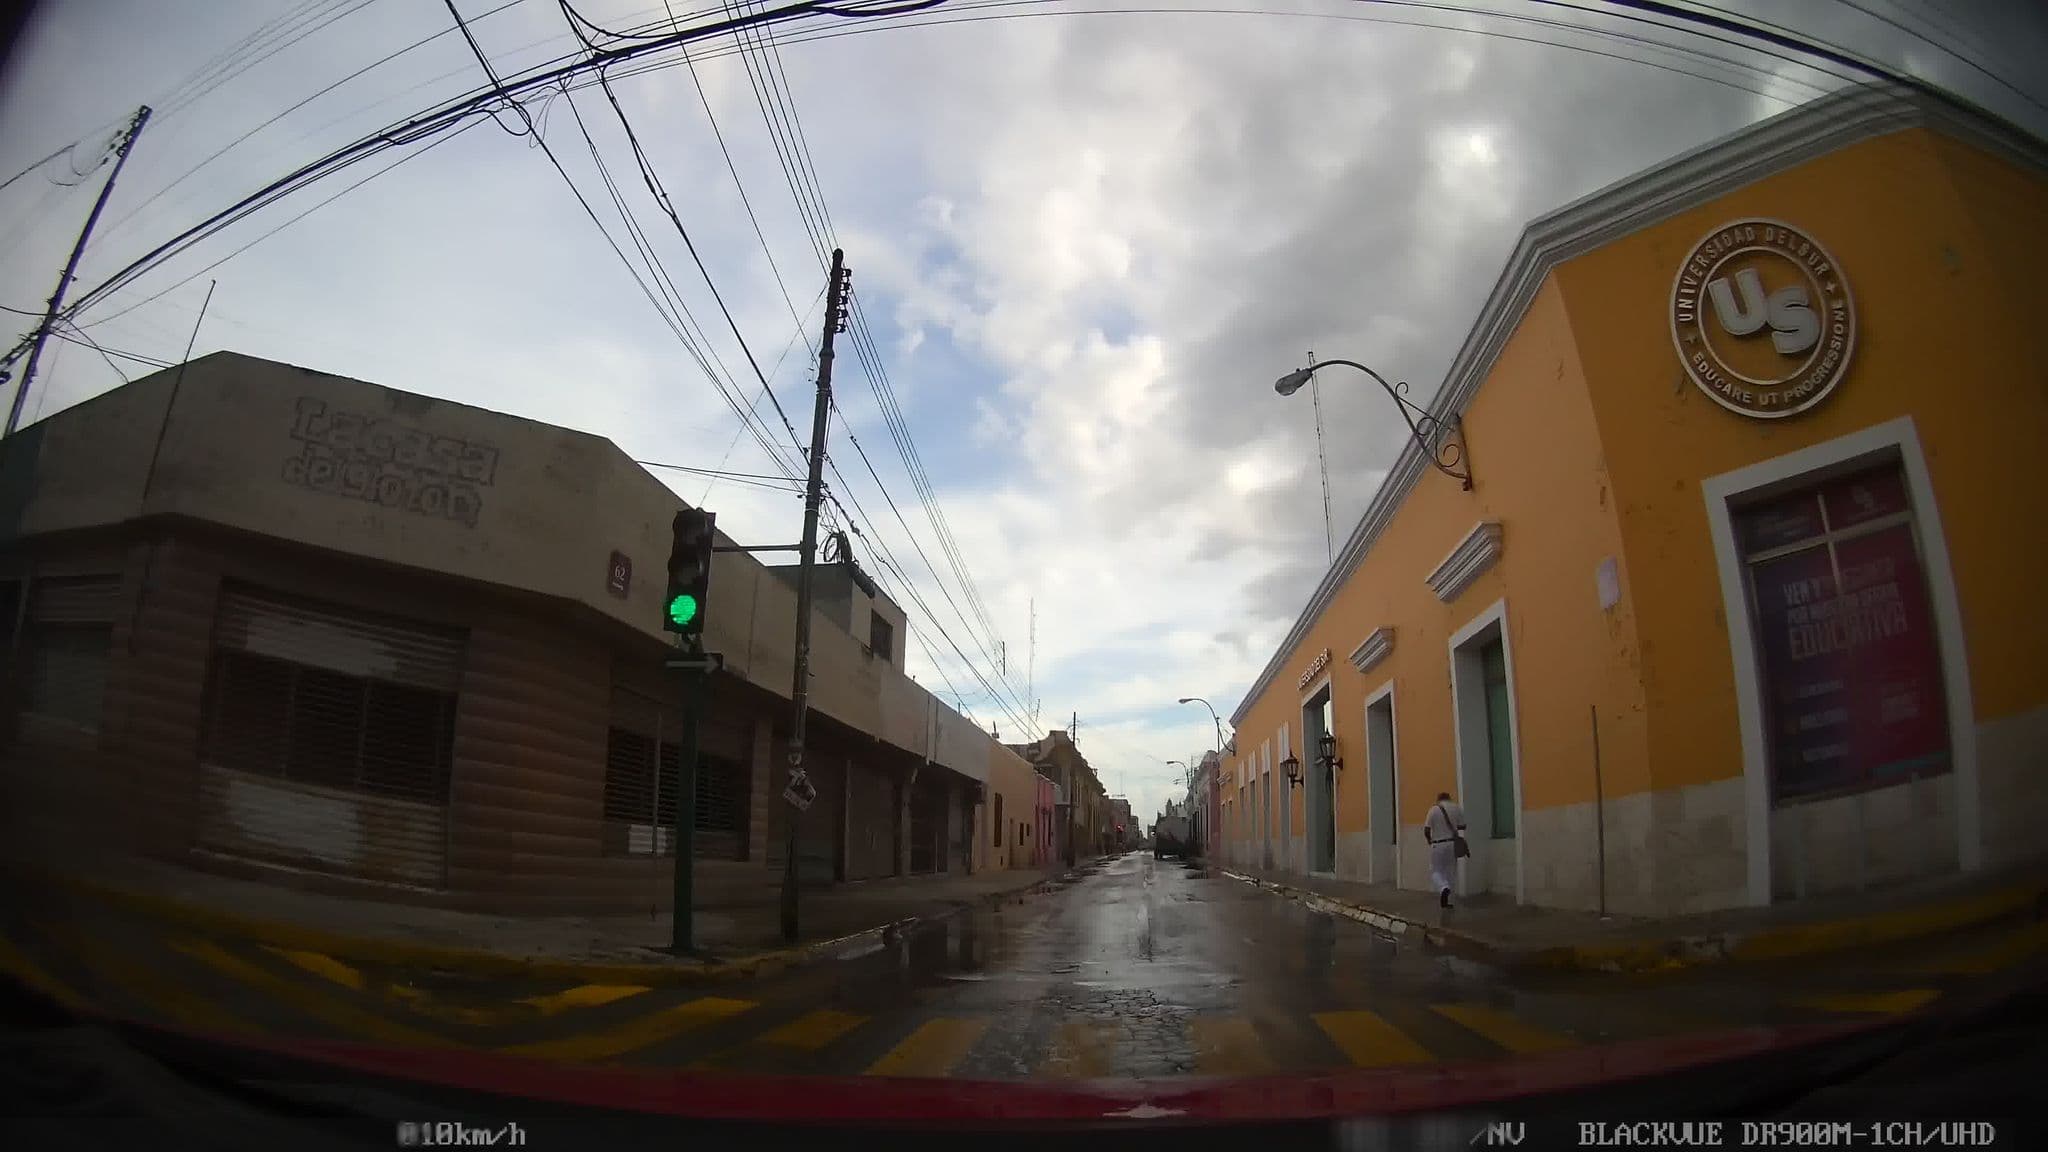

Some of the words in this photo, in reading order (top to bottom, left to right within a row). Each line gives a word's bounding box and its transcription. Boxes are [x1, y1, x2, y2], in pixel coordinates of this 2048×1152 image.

[1678, 226, 1755, 322] UNIVERSIDAD
[1708, 267, 1820, 354] US
[1693, 351, 1753, 404] EDUCARE
[1759, 391, 1778, 406] UT
[615, 564, 625, 581] 62
